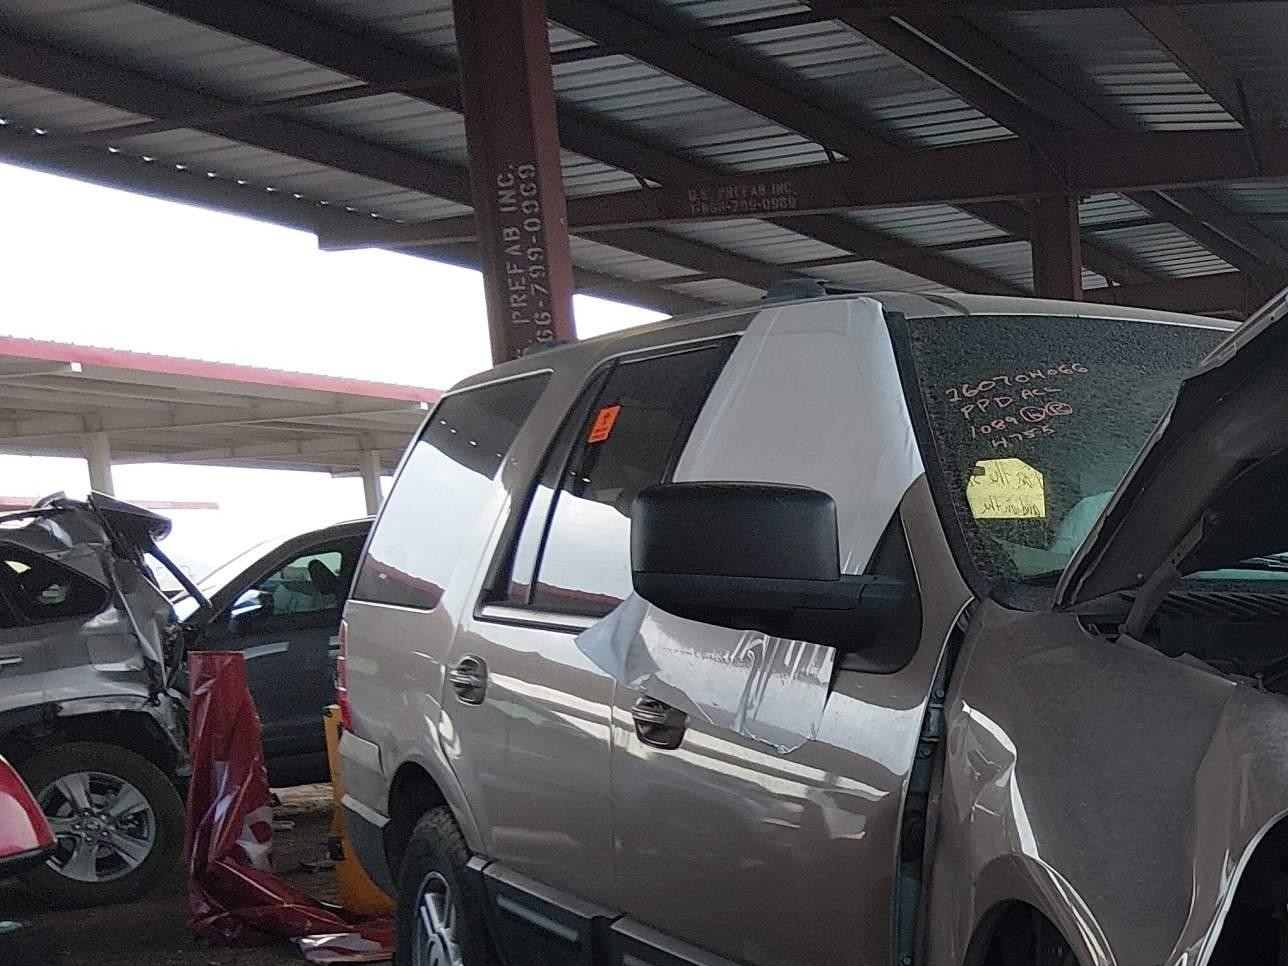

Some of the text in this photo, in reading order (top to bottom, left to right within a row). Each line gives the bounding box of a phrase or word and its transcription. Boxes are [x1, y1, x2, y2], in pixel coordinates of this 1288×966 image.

[502, 225, 531, 325] PREFAB
[517, 162, 555, 342] 66-799-0969
[960, 396, 1014, 420] PPD
